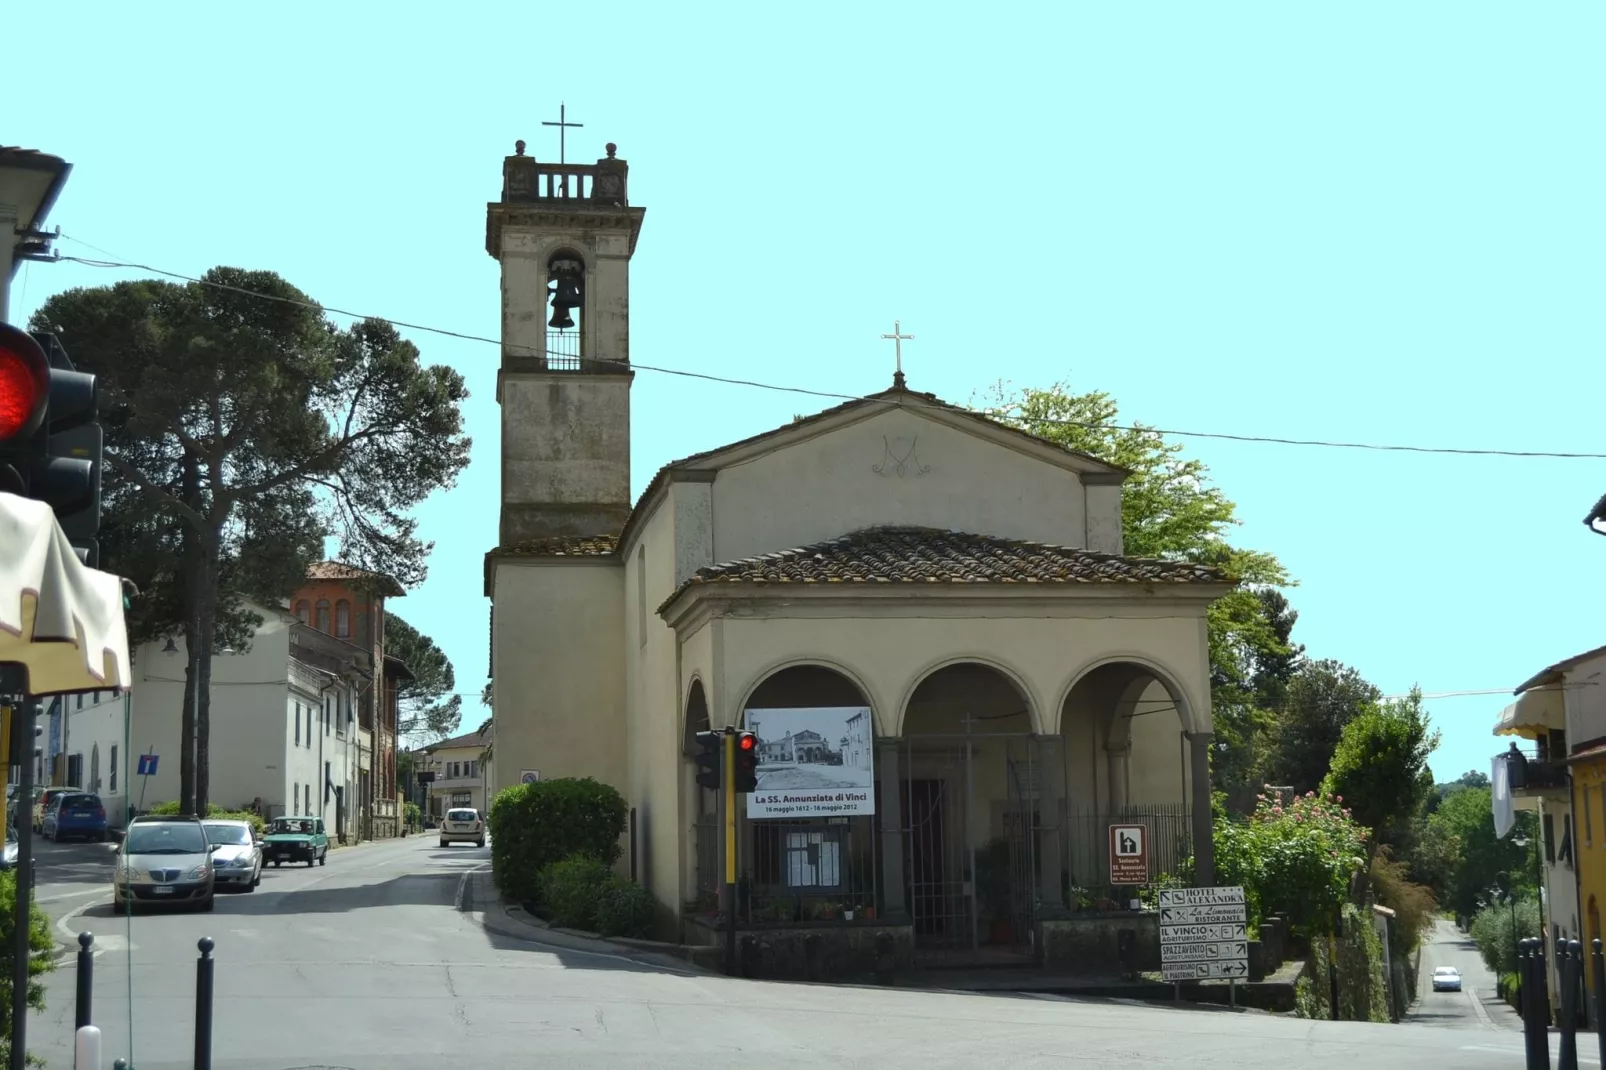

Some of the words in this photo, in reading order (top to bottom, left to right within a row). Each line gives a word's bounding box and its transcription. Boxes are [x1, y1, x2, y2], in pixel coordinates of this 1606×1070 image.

[783, 794, 833, 803] Annunziata
[835, 794, 843, 802] di
[845, 793, 867, 801] Vinci
[1186, 888, 1217, 896] HOTEL
[1187, 895, 1243, 904] ALEXANDRA
[1189, 907, 1202, 916] La
[1204, 906, 1244, 916] Limonaia
[1173, 926, 1207, 935] VINCIO
[1163, 945, 1205, 955] SPAZZAVENTO
